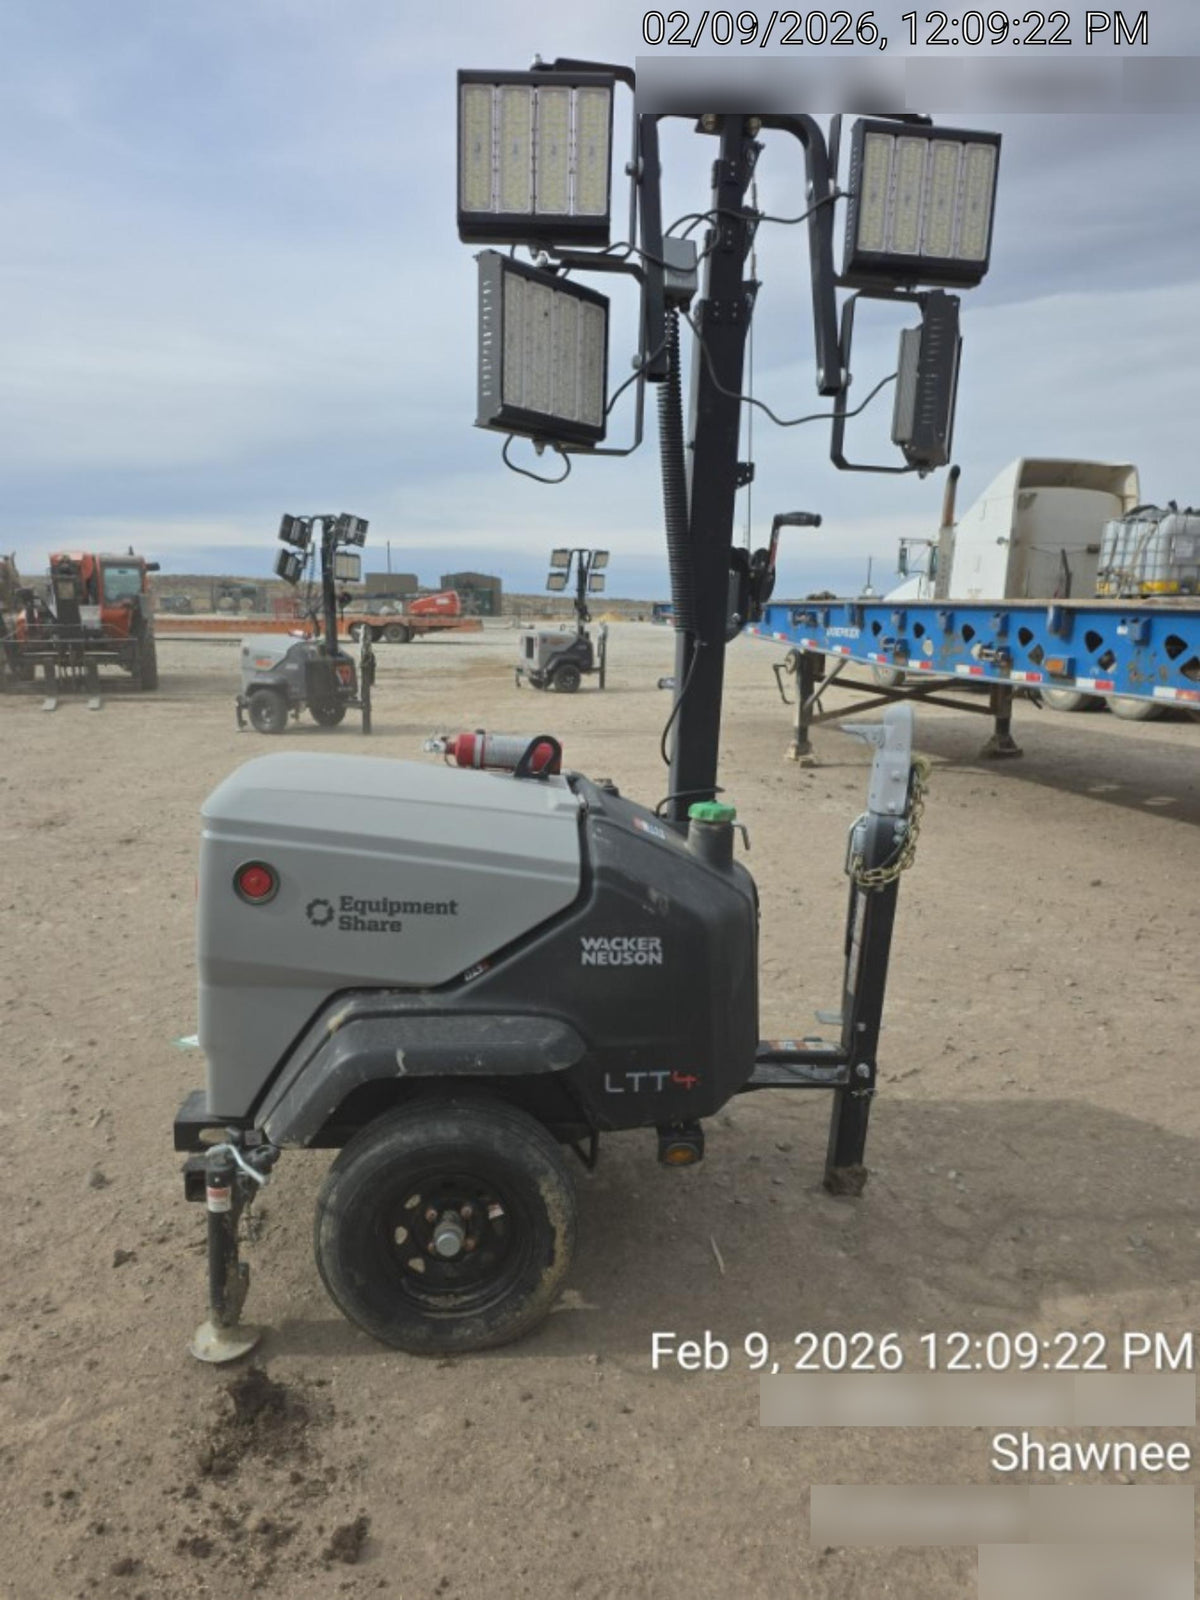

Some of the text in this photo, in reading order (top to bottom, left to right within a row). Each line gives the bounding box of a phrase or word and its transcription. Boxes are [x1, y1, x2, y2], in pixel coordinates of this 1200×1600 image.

[339, 896, 458, 916] Equipment
[339, 916, 402, 932] Share
[581, 937, 662, 950] WACKER
[581, 951, 662, 965] NEUSON
[605, 1071, 698, 1092] LTT4
